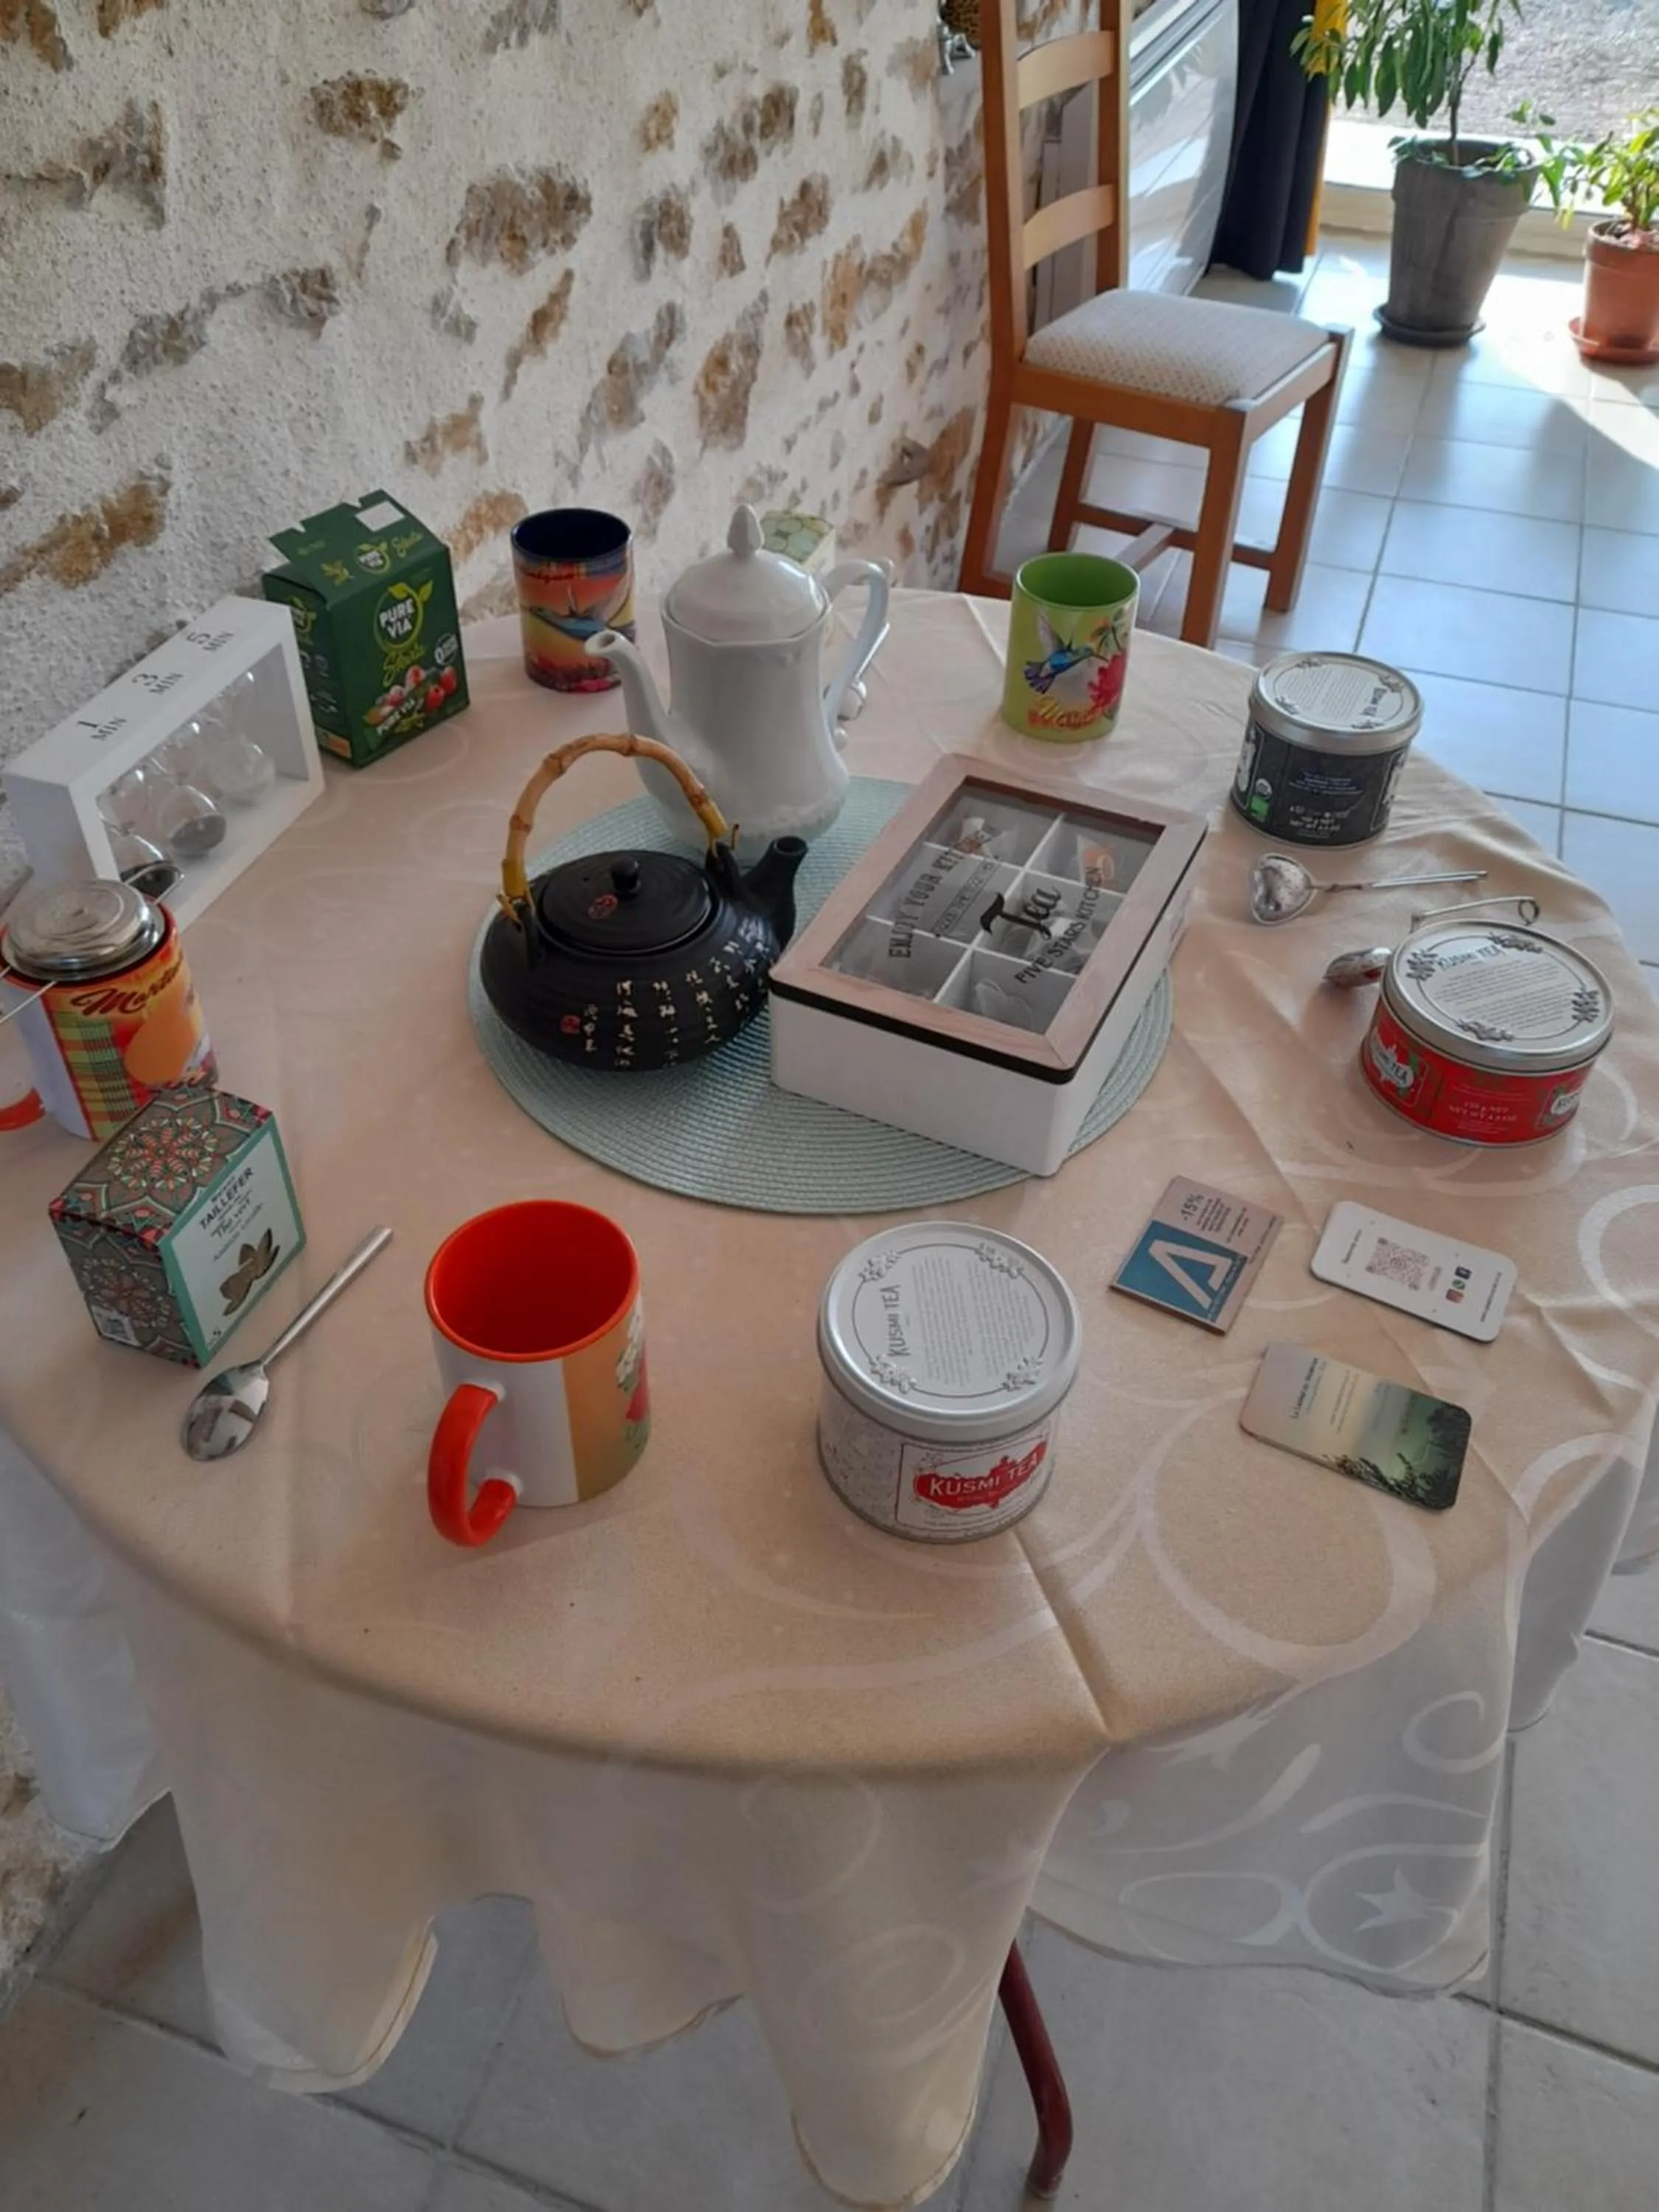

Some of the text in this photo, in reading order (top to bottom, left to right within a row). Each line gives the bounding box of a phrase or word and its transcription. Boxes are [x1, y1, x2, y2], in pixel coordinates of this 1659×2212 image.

[379, 599, 415, 628] PURE
[187, 632, 211, 645] 5
[202, 631, 234, 652] MIN
[386, 619, 413, 639] VIA
[131, 673, 159, 686] 3
[149, 672, 184, 694] MIN
[77, 720, 98, 728] 1
[91, 716, 127, 740] MIN
[902, 873, 943, 907] YOUR
[980, 886, 1062, 941] Tea
[888, 911, 919, 959] ENJOY
[1014, 956, 1053, 984] FIVE
[1047, 922, 1086, 958] STARS
[199, 1167, 254, 1230] TAILLEFER
[1180, 1192, 1205, 1221] -15%
[880, 1284, 911, 1357] KUSMI TEA
[930, 1452, 1038, 1497] KUSMI TEA
